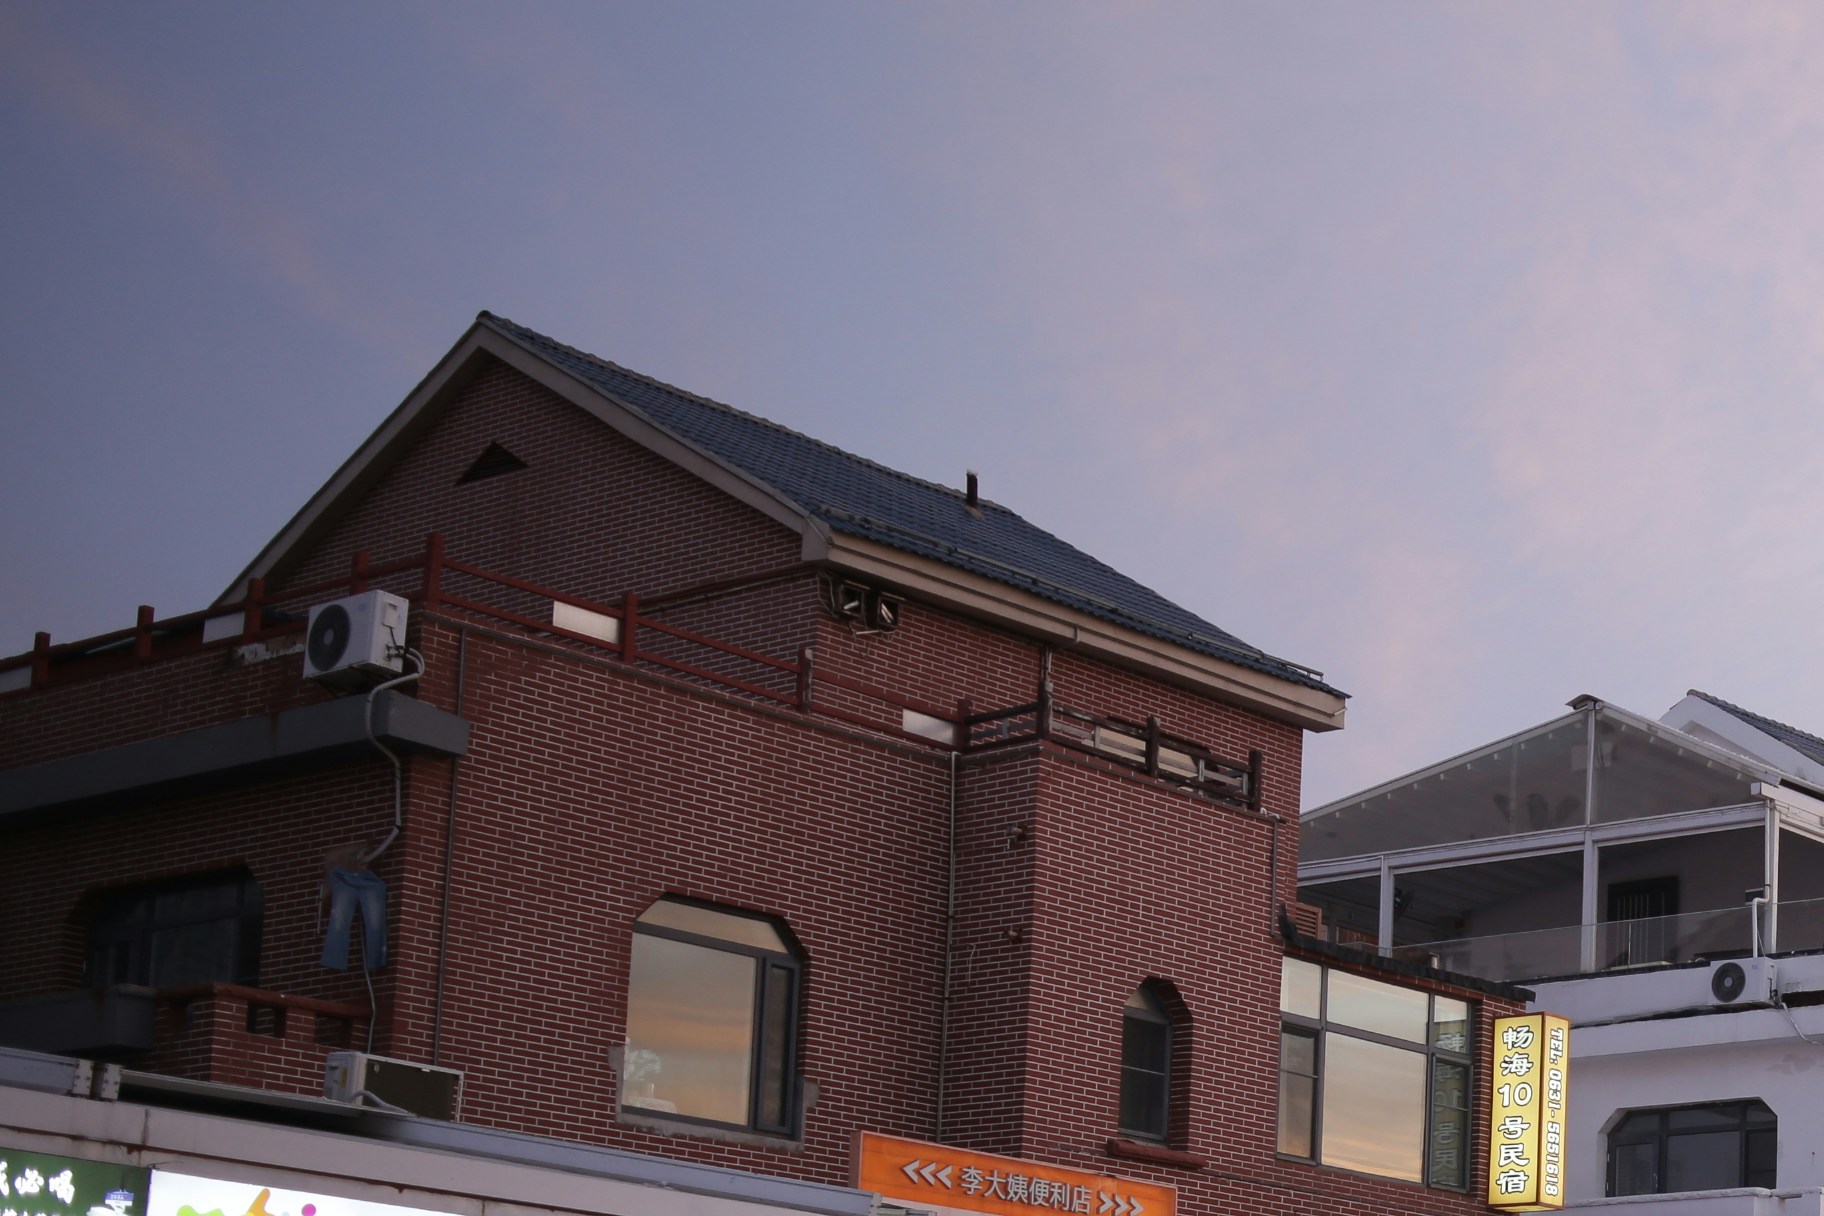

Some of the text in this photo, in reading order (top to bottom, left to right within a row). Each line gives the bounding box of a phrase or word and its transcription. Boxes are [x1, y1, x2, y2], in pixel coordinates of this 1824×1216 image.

[1548, 1028, 1564, 1064] TEL:
[1496, 1025, 1535, 1195] 畅海10号民宿
[961, 1166, 1093, 1215] 李大姨便利店
